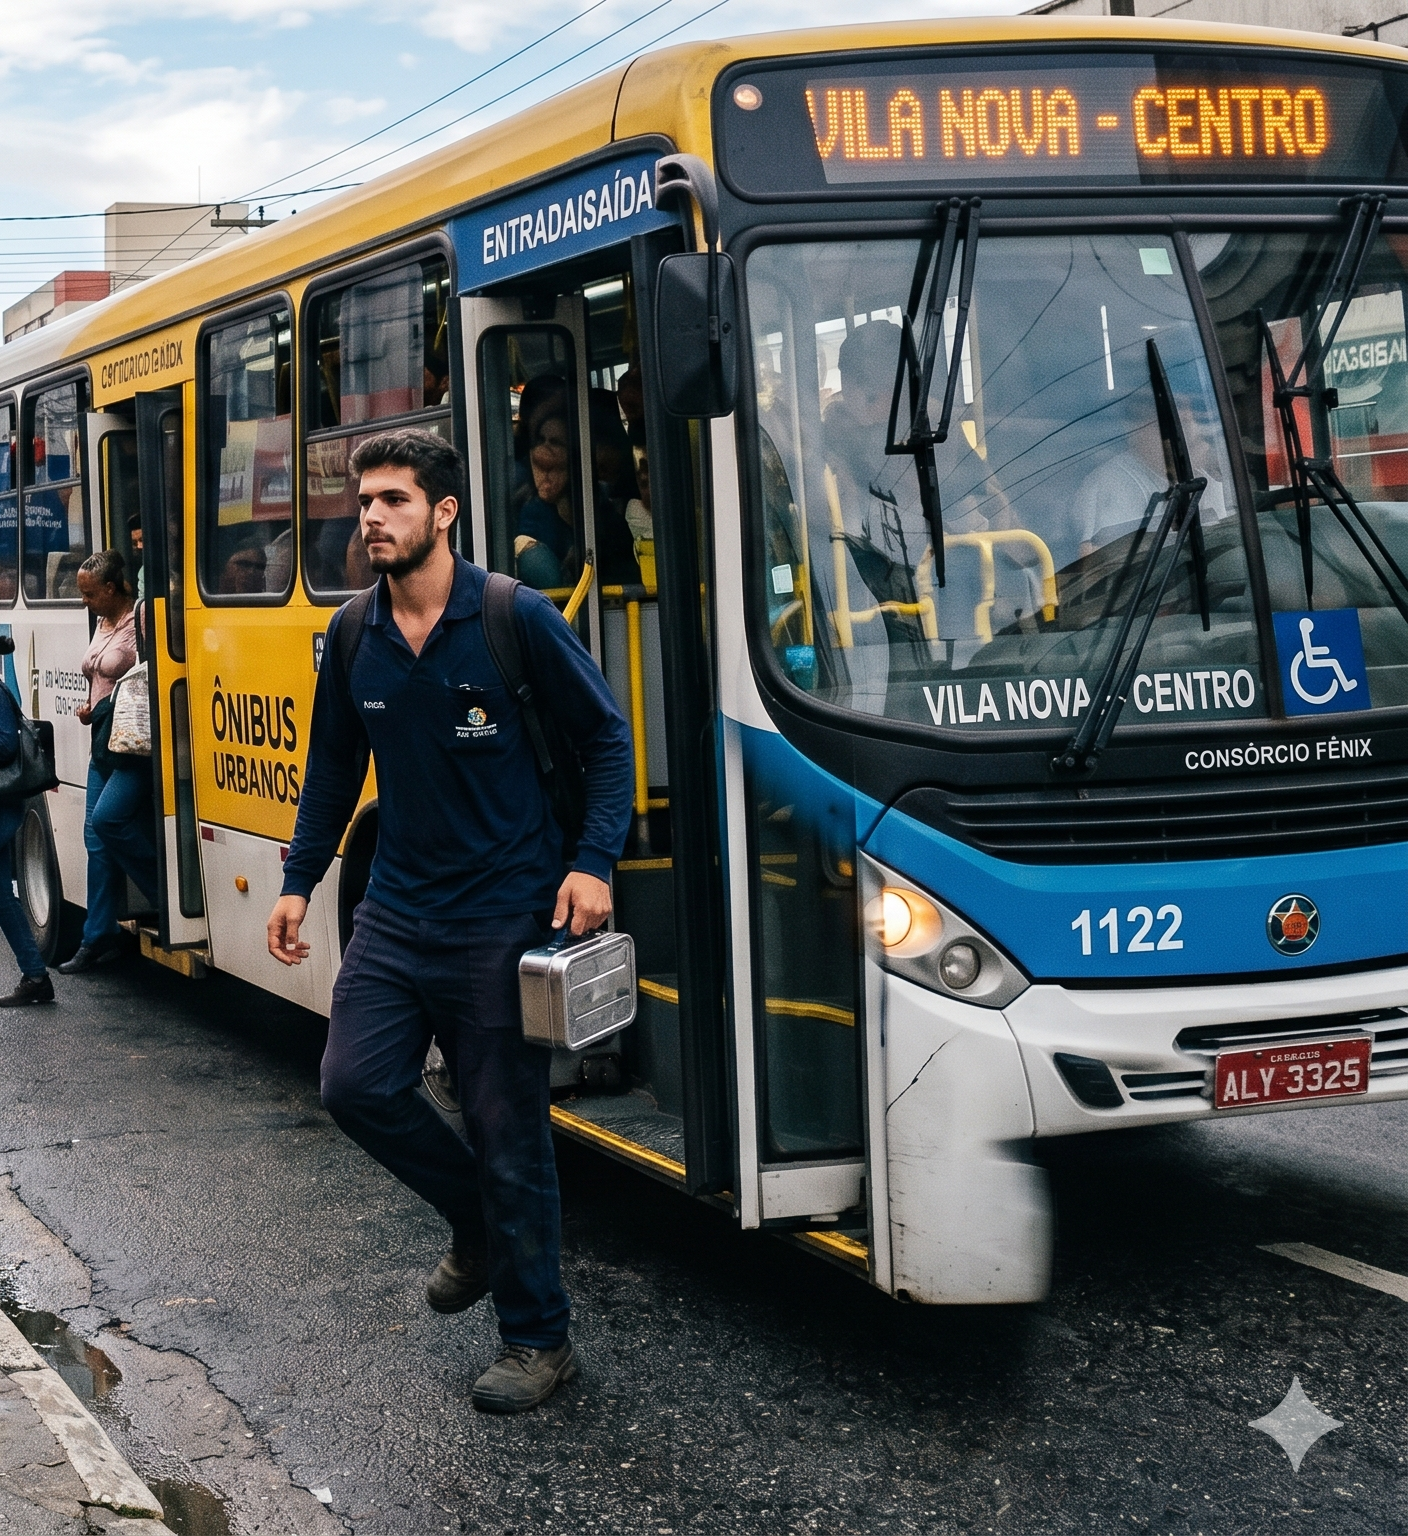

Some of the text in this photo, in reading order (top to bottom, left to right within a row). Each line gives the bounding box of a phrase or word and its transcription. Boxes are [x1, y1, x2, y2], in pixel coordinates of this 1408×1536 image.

[805, 89, 925, 160] VILA
[940, 88, 1082, 158] NOVA
[1133, 87, 1330, 157] CENTRO
[211, 674, 297, 753] ÔNIBUS
[922, 669, 1256, 726] VILA NOVA CENTRO
[213, 751, 301, 807] URBANOS
[1185, 735, 1373, 770] CONSÓRCIO FÊNIX
[1071, 904, 1184, 956] 1122
[1223, 1058, 1360, 1102] ALY 3325
